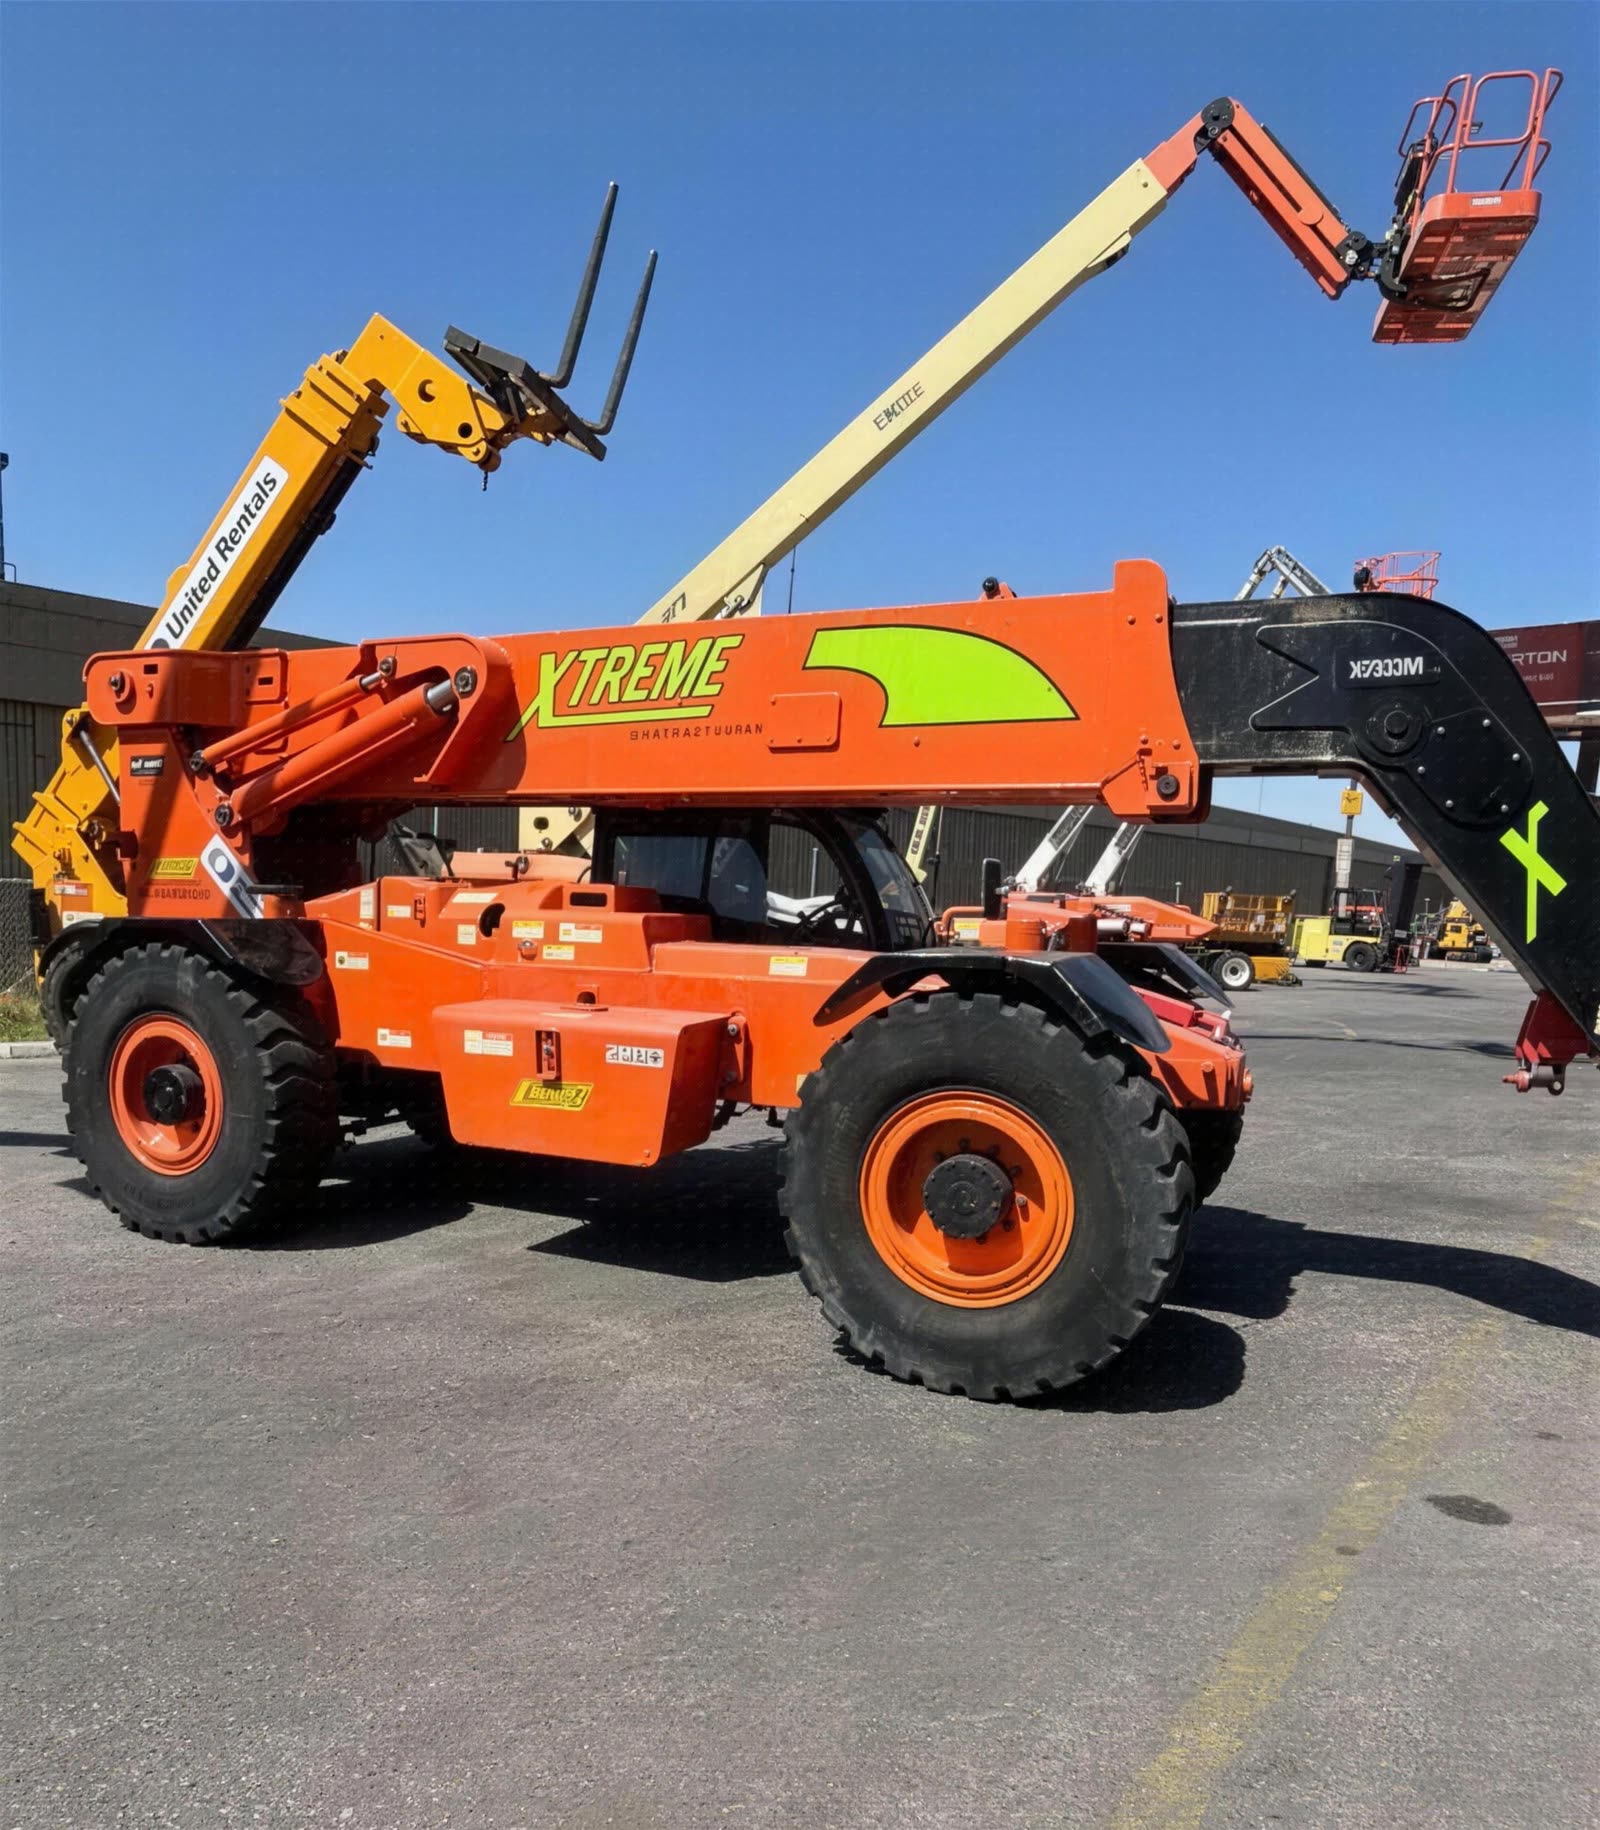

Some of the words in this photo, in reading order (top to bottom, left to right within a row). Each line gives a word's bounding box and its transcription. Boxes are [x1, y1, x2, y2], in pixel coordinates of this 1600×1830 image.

[166, 557, 221, 639] United
[215, 472, 277, 562] Rentals
[503, 633, 745, 741] XTREME
